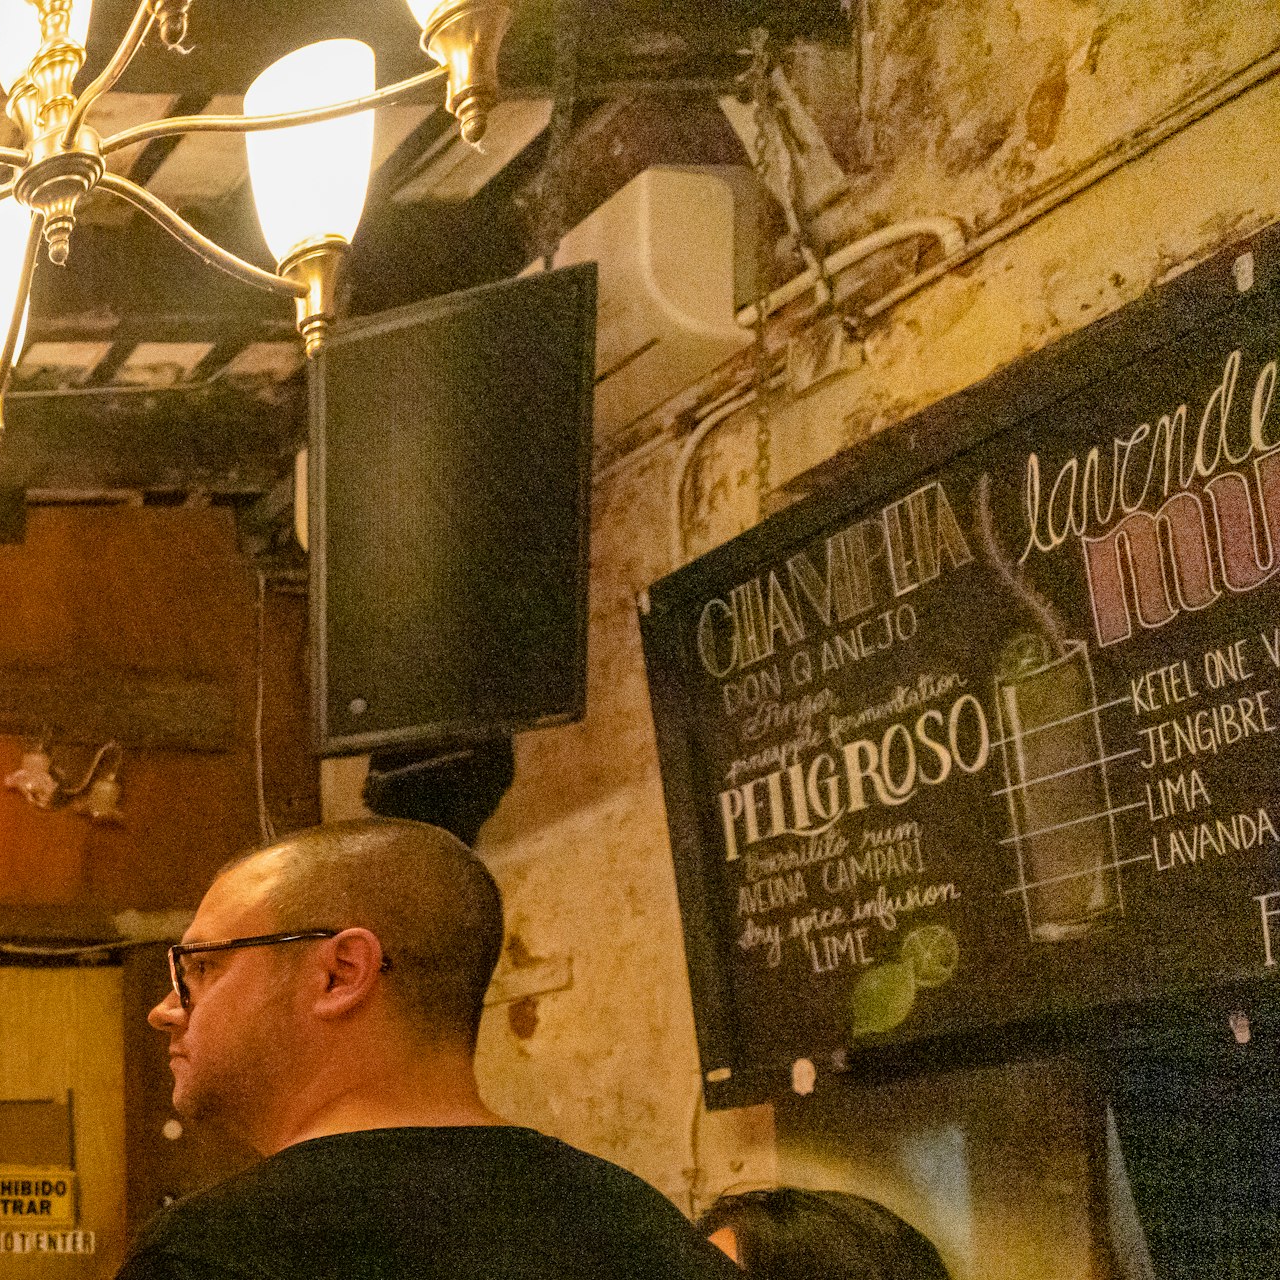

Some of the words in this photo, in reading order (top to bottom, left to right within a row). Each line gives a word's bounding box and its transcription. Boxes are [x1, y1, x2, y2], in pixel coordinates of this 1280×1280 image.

[723, 665, 782, 715] DON
[791, 651, 813, 686] Q
[1131, 660, 1199, 716] KETEL
[1204, 639, 1254, 689] ONE
[1138, 690, 1278, 769] JENGIBRE
[720, 694, 990, 863] PELIGROSO
[1146, 769, 1212, 822] LIMA
[860, 821, 923, 851] rum
[1152, 809, 1280, 872] LAVANDA
[823, 838, 925, 895] CAMPARI
[851, 880, 962, 930] infusion
[810, 927, 874, 973] LIME
